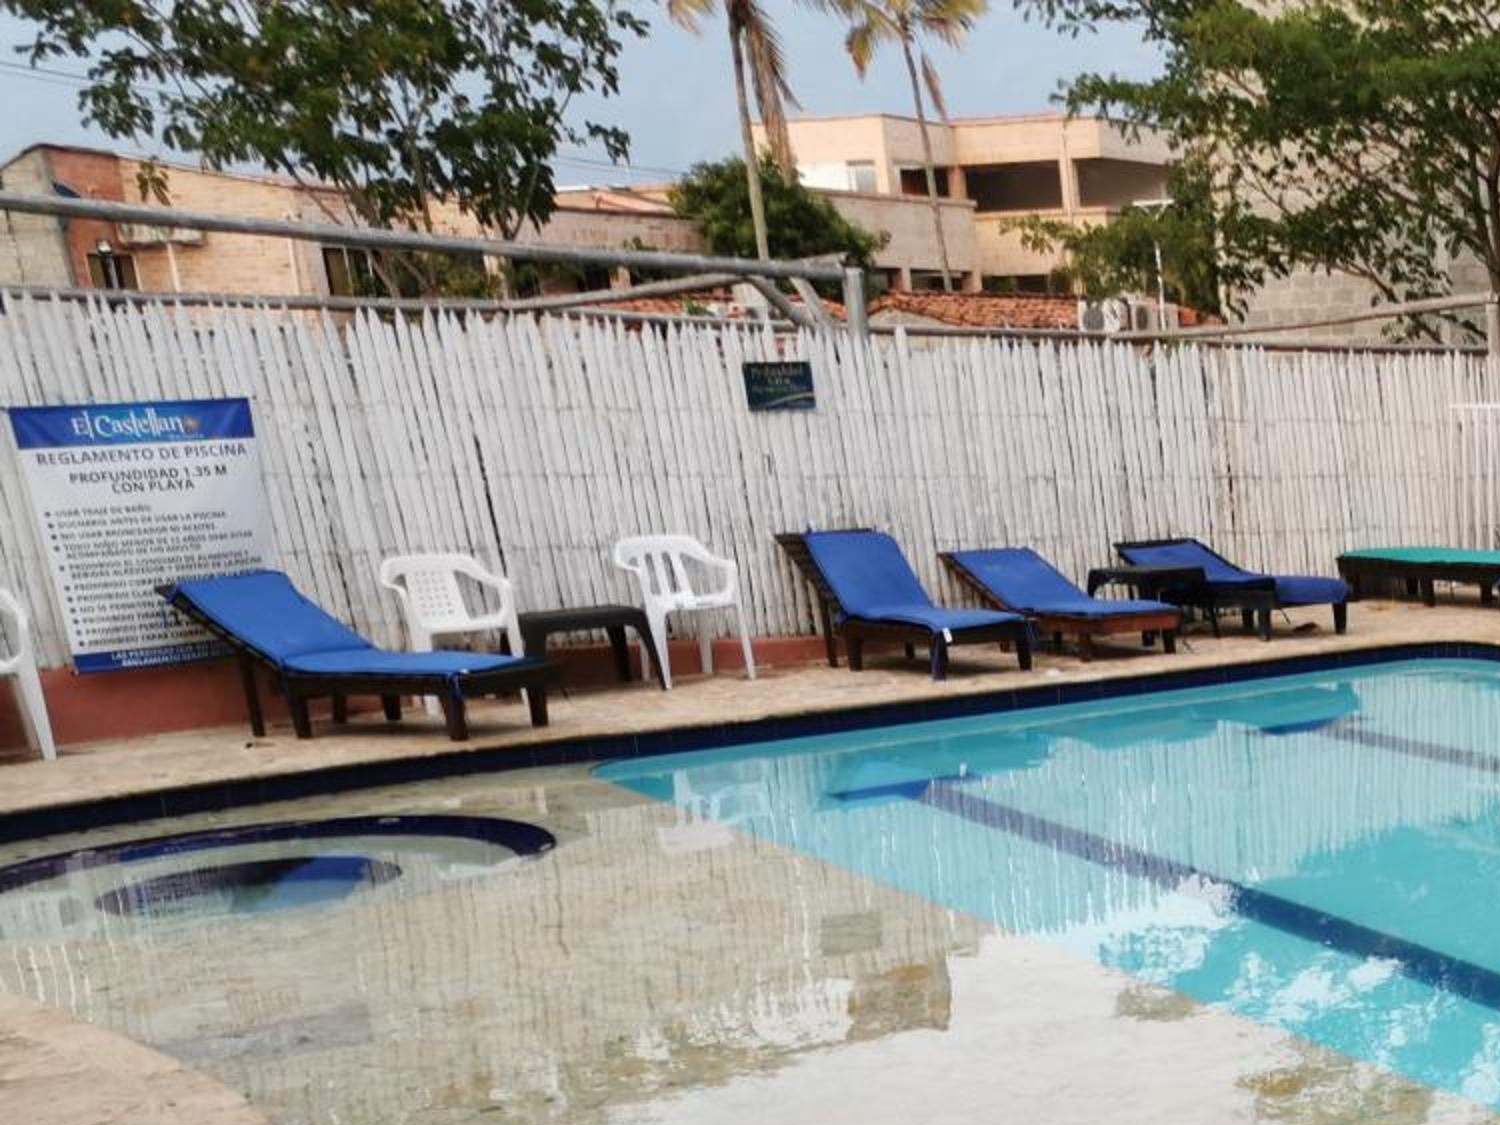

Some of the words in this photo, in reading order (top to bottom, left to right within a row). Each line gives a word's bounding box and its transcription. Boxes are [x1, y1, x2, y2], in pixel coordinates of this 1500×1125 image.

[71, 410, 94, 440] El
[36, 448, 154, 466] REGLAMENTO
[159, 447, 182, 460] DE
[185, 443, 247, 457] PISCINA
[69, 469, 179, 484] PROFUNDIDAD
[184, 466, 211, 478] 1.35
[215, 465, 227, 476] M
[111, 481, 145, 494] CON
[149, 479, 195, 492] PLAYA
